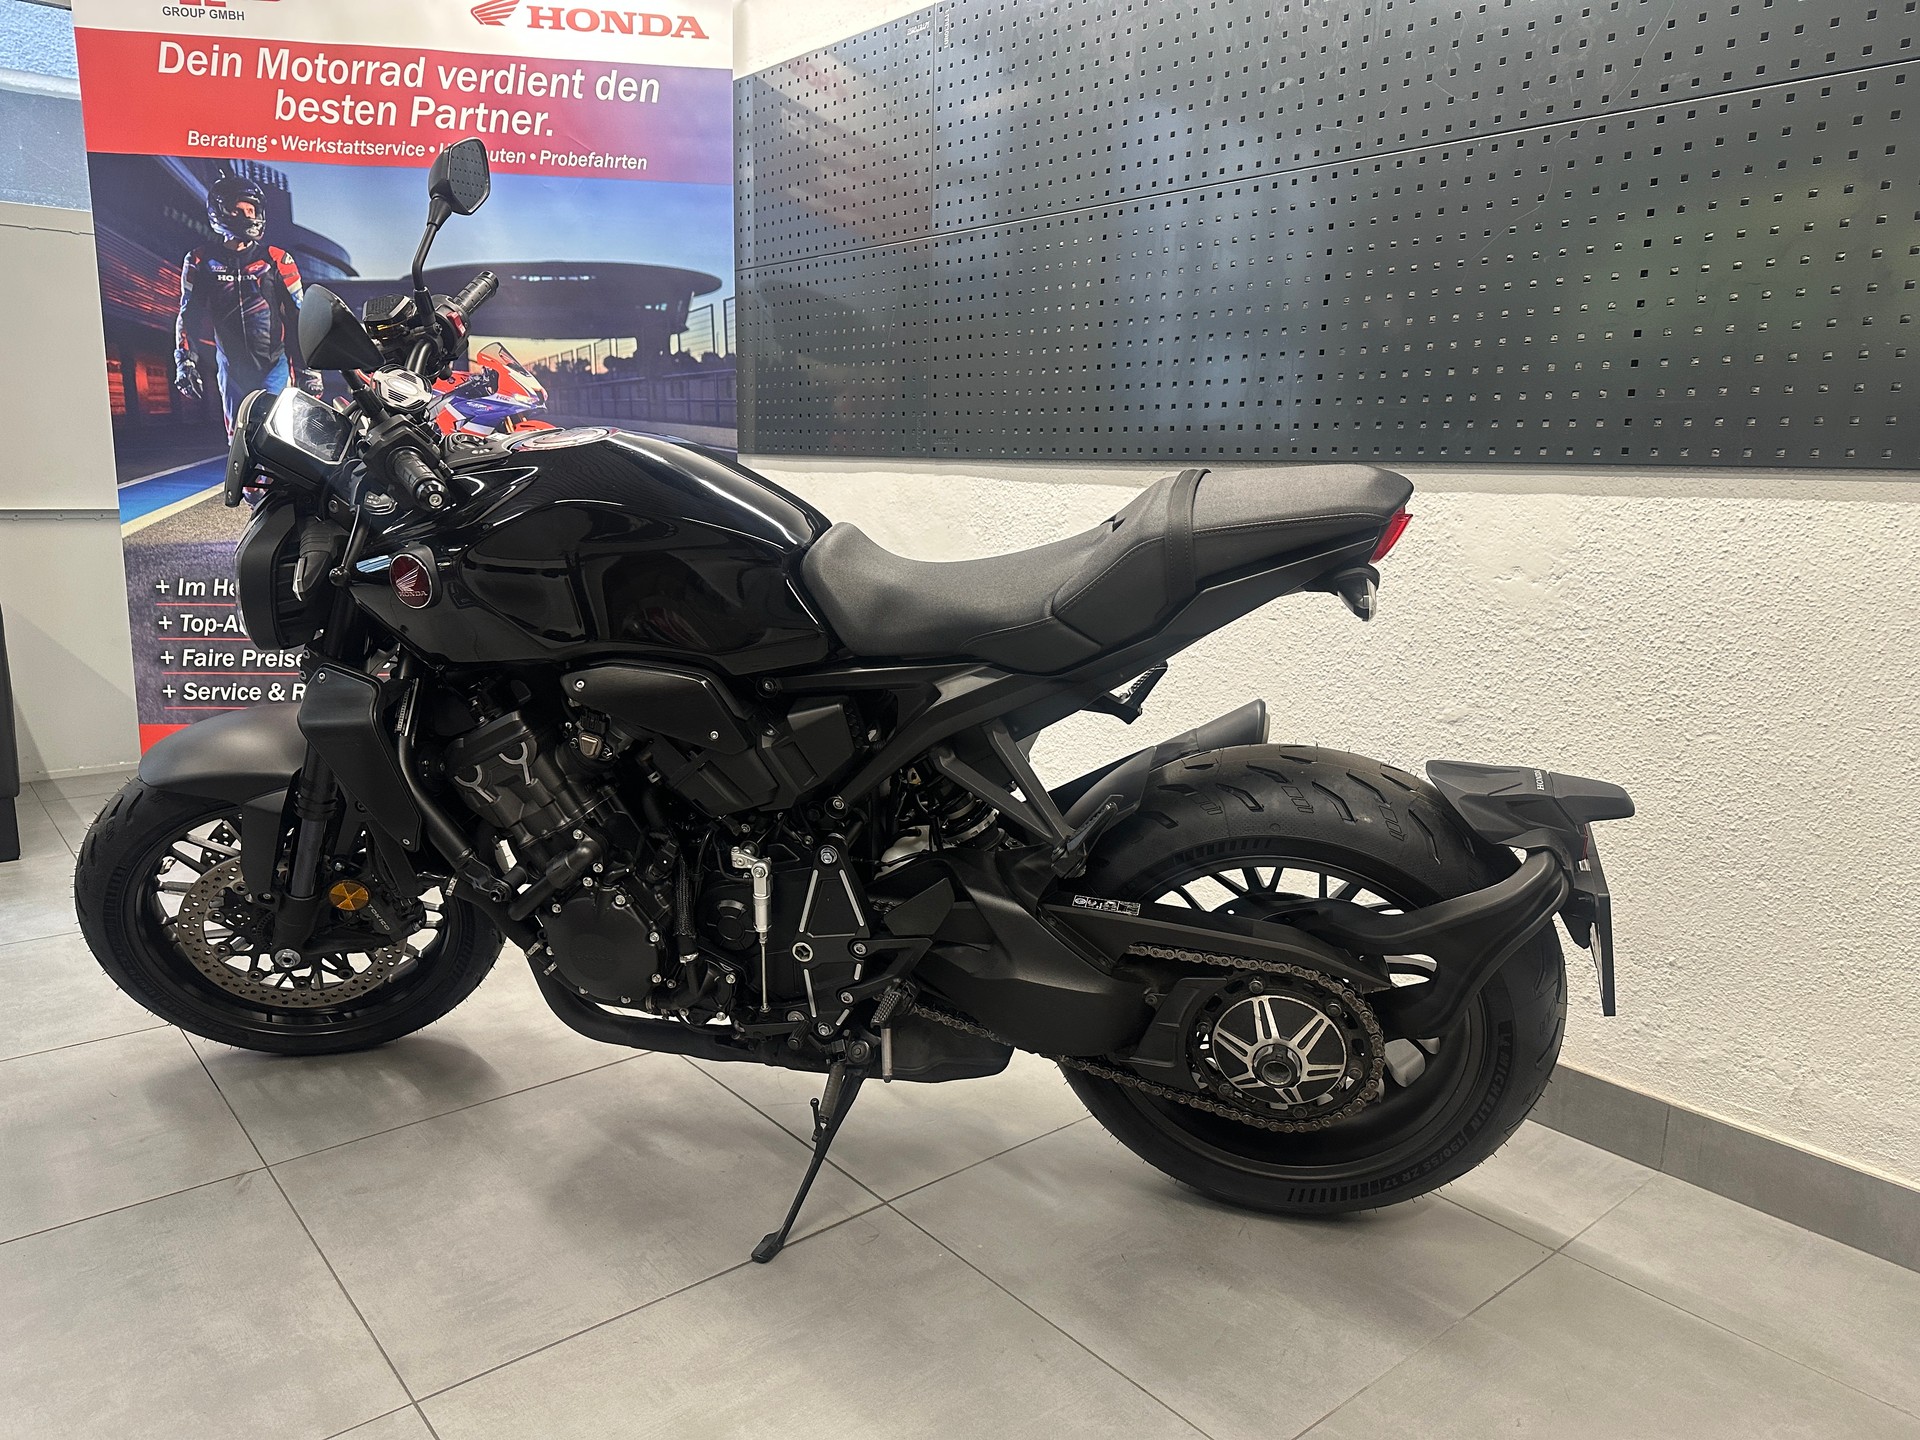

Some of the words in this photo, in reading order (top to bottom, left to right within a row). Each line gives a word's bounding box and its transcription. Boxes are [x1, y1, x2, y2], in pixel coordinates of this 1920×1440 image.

[162, 6, 206, 18] GROUP
[209, 9, 245, 21] GMBH
[527, 5, 710, 40] HONDA
[158, 41, 243, 78] Dein
[256, 47, 426, 89] Motorrad
[437, 63, 585, 99] verdient
[595, 69, 661, 104] den
[275, 88, 397, 127] besten
[410, 96, 554, 137] Partner.
[187, 130, 268, 153] Beratung
[280, 135, 426, 157] Werkstattservice
[539, 149, 648, 170] Probefahrten
[178, 577, 206, 596] Im
[182, 648, 235, 668] Faire
[183, 682, 262, 702] Service
